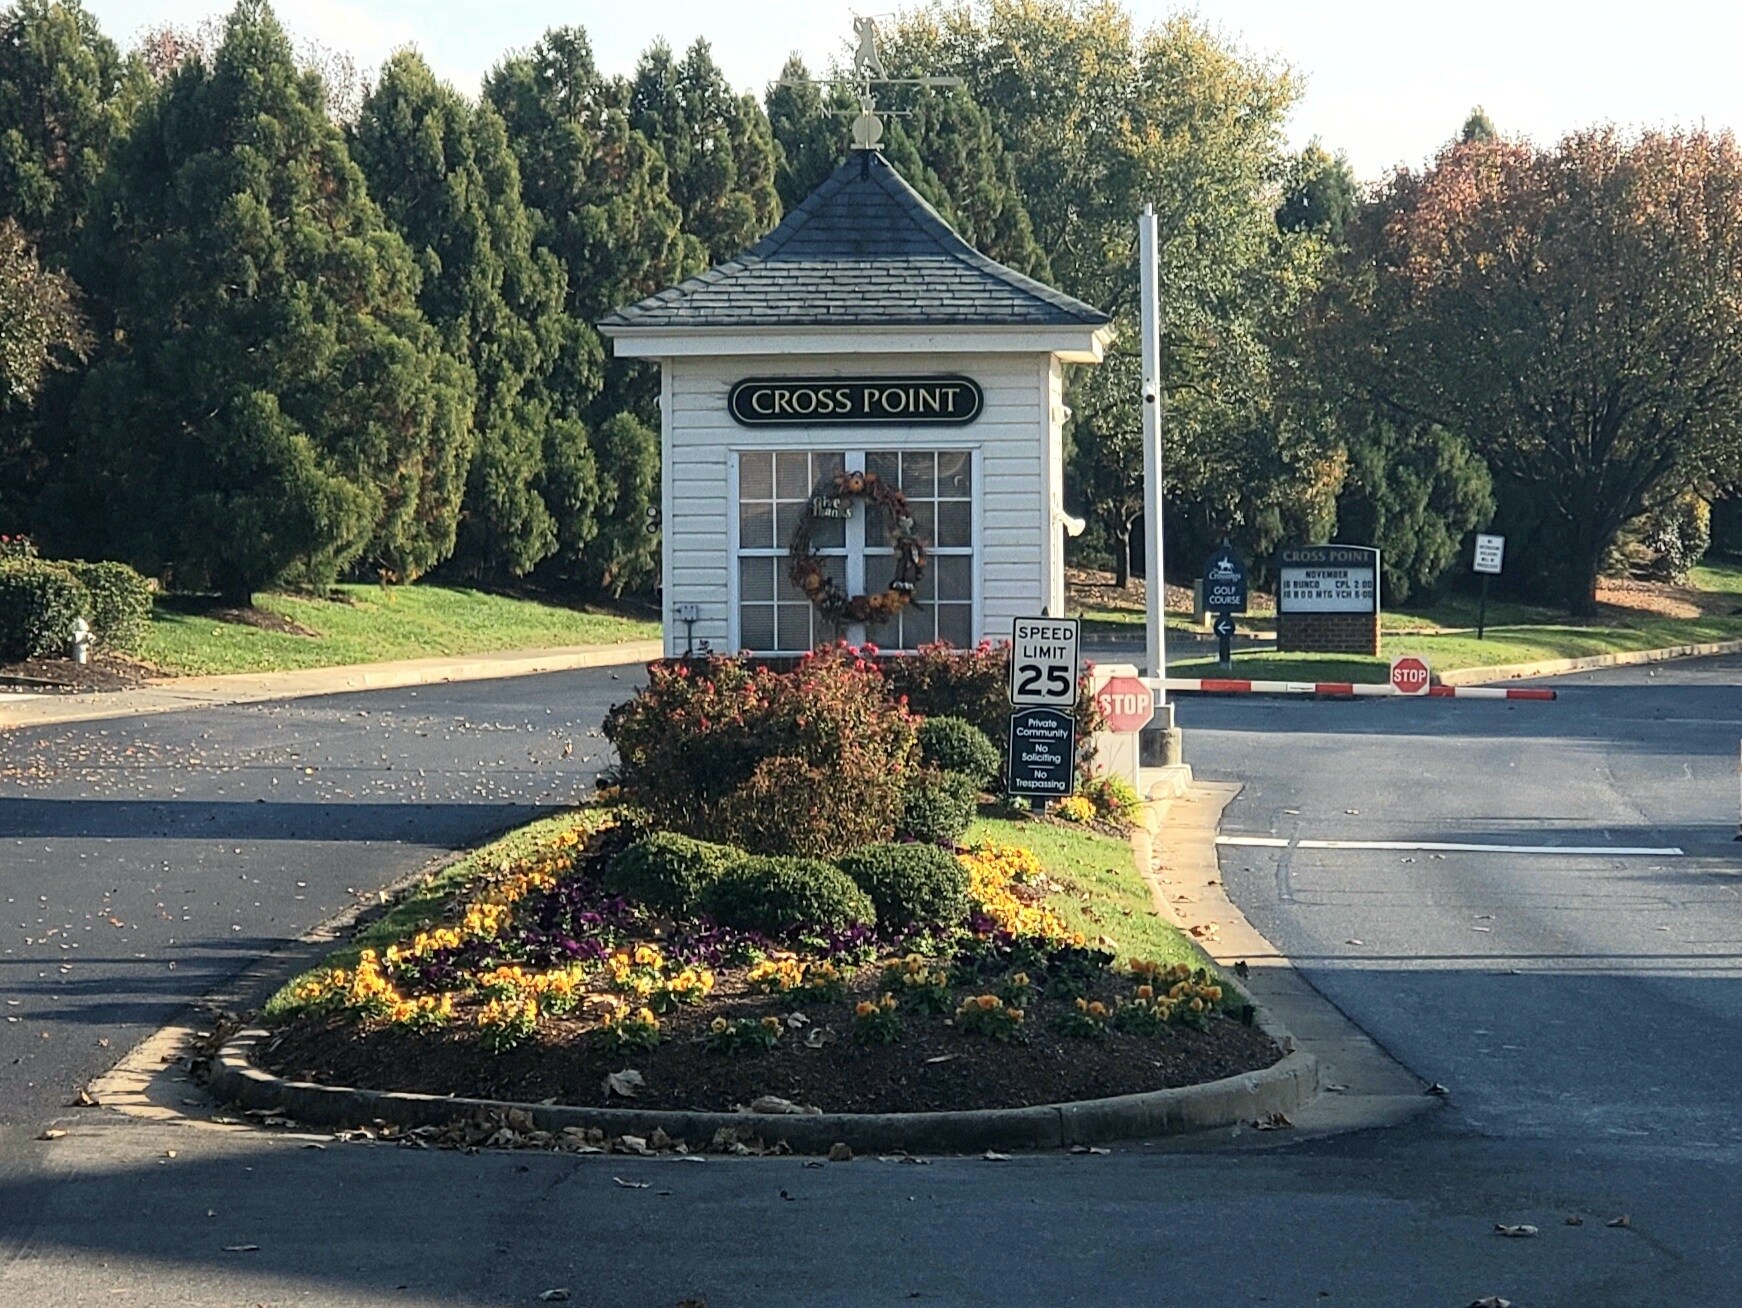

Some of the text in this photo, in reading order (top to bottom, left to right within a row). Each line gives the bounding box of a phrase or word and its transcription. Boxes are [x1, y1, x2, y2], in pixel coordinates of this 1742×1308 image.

[752, 388, 960, 413] CROSS POINT
[1283, 551, 1370, 561] CROSS POINT
[1305, 570, 1348, 579] NOVEMBER
[1213, 586, 1236, 595] GOLF
[1335, 580, 1351, 588] CPL
[1209, 595, 1240, 604] COURSE
[1018, 626, 1073, 641] SPEED
[1023, 645, 1066, 659] LIMIT
[1017, 664, 1070, 697] 25
[1393, 668, 1426, 683] STOP
[1100, 693, 1149, 716] STOP
[1028, 718, 1057, 728] Private
[1016, 727, 1068, 740] Community
[1035, 743, 1048, 753] No
[1021, 751, 1061, 765] Soliciting
[1034, 770, 1047, 779] No
[1015, 778, 1065, 791] Trespassing
